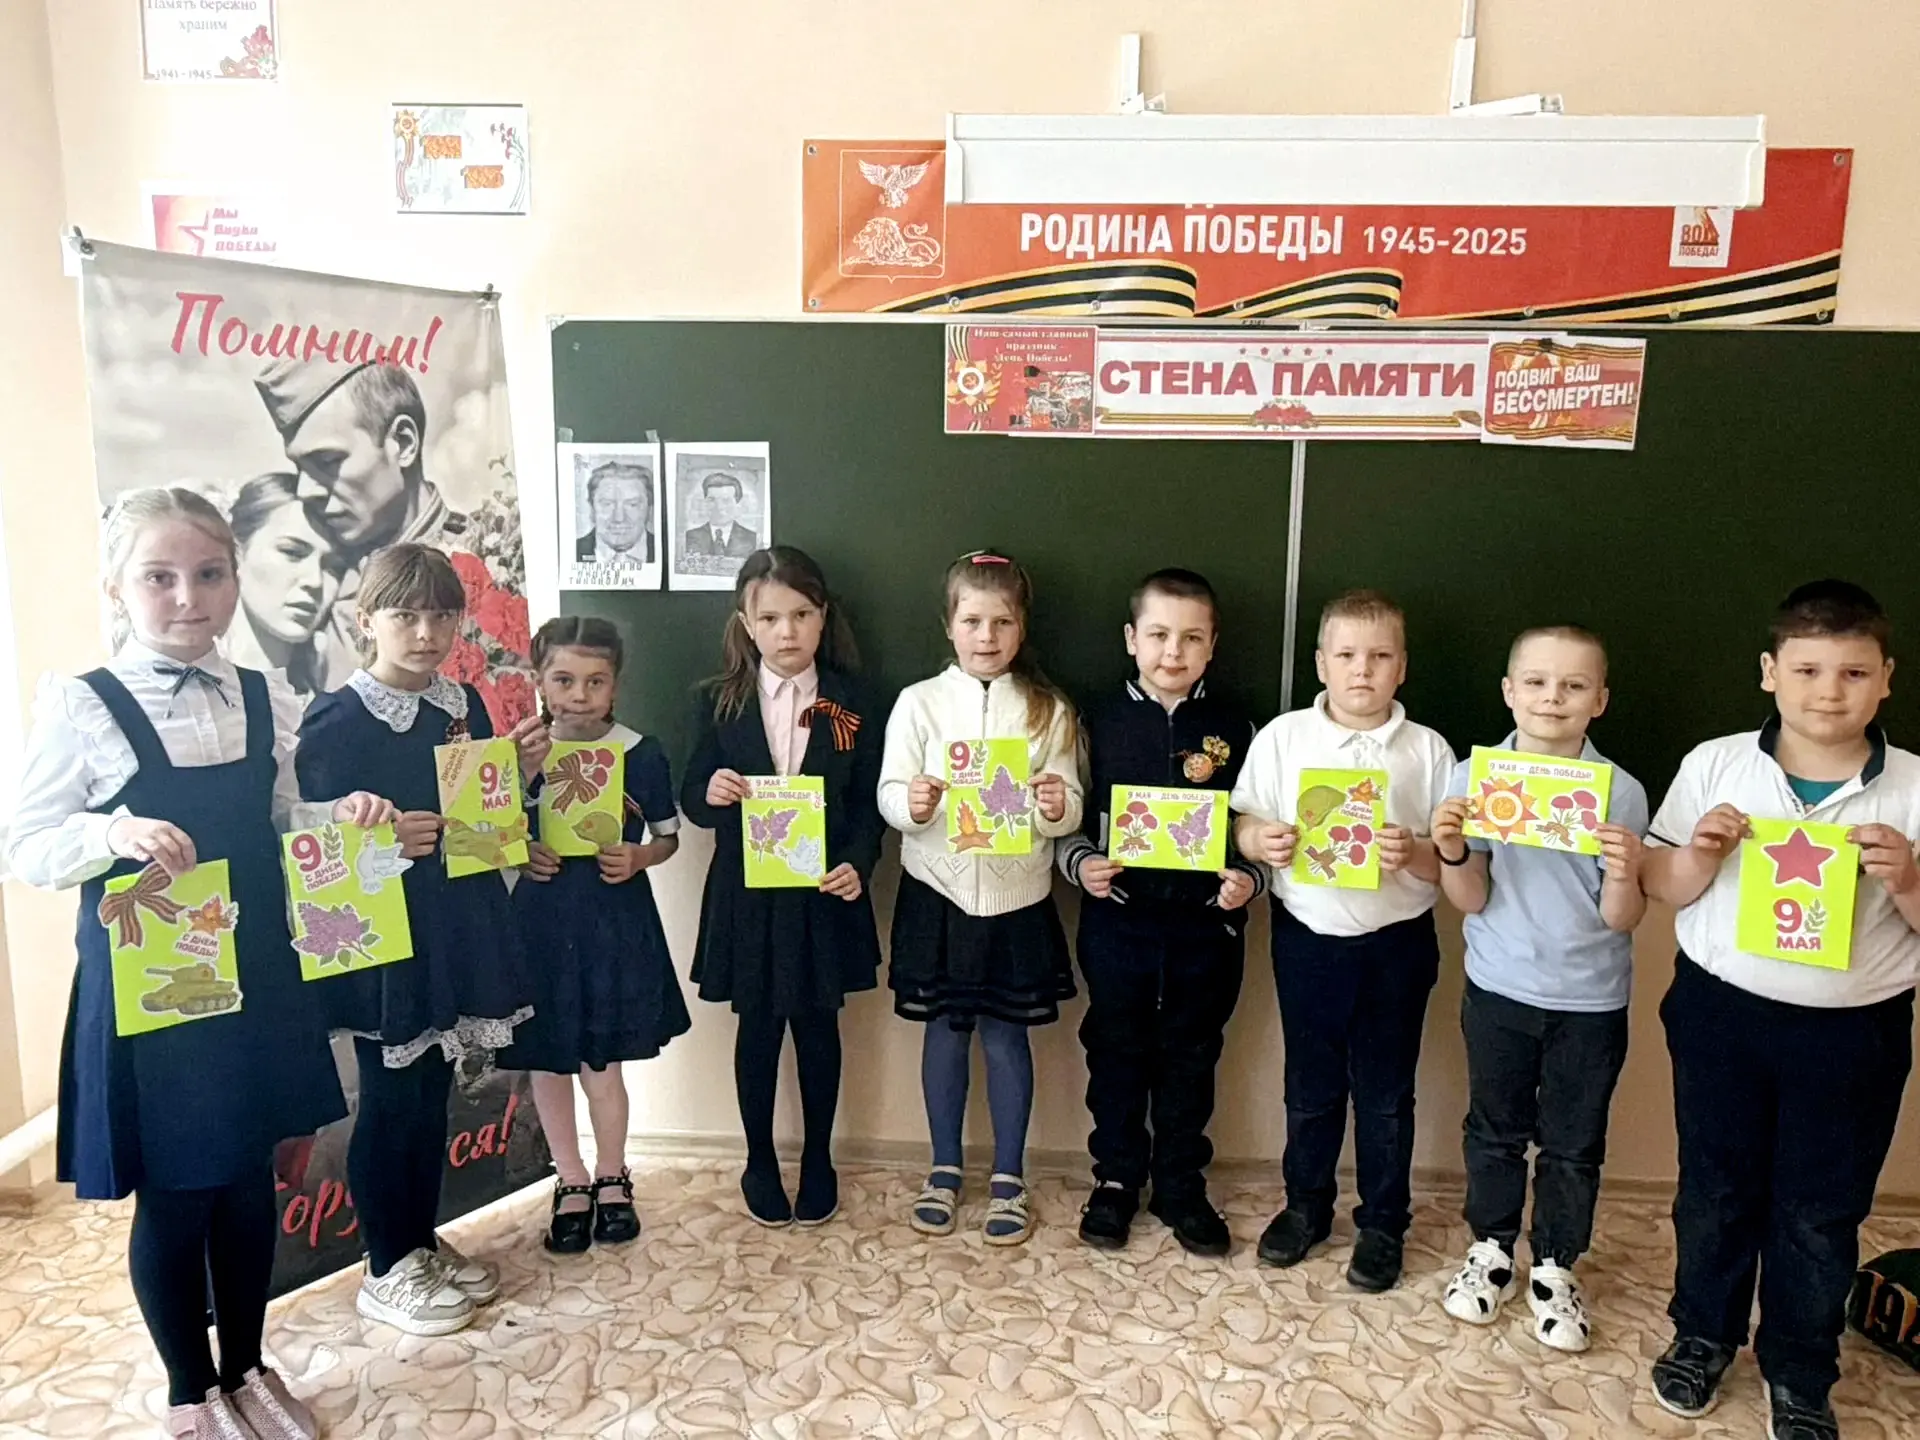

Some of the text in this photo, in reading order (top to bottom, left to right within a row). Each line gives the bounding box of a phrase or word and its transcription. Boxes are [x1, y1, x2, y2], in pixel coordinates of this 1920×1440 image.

[147, 0, 257, 13] Память бережно
[179, 20, 228, 33] храним
[188, 70, 213, 80] 1945
[215, 241, 277, 252] ПОБЕДЫ
[1020, 213, 1527, 260] РОДИНА ПОБЕДЫ 1945-2025
[1678, 246, 1719, 258] ПОБЕДА!
[169, 291, 443, 375] Помним!
[974, 328, 1000, 339] Наш
[1002, 328, 1039, 339] самый
[1100, 359, 1475, 398] СТЕНА ПАМЯТИ
[1494, 363, 1601, 390] ПОДВИГ ВАШ
[1492, 381, 1635, 416] БЕССМЕРТЕН!
[949, 741, 970, 771] 9
[479, 762, 498, 794] 9
[1498, 763, 1517, 772] МАЯ
[1528, 766, 1551, 775] ДЕНЬ
[482, 794, 512, 812] МАЯ
[291, 833, 322, 871] 9
[305, 860, 343, 882] С ДНЕМ
[1773, 897, 1802, 933] 9
[182, 933, 218, 947] С ДНЕМ
[1776, 936, 1821, 951] МАЯ
